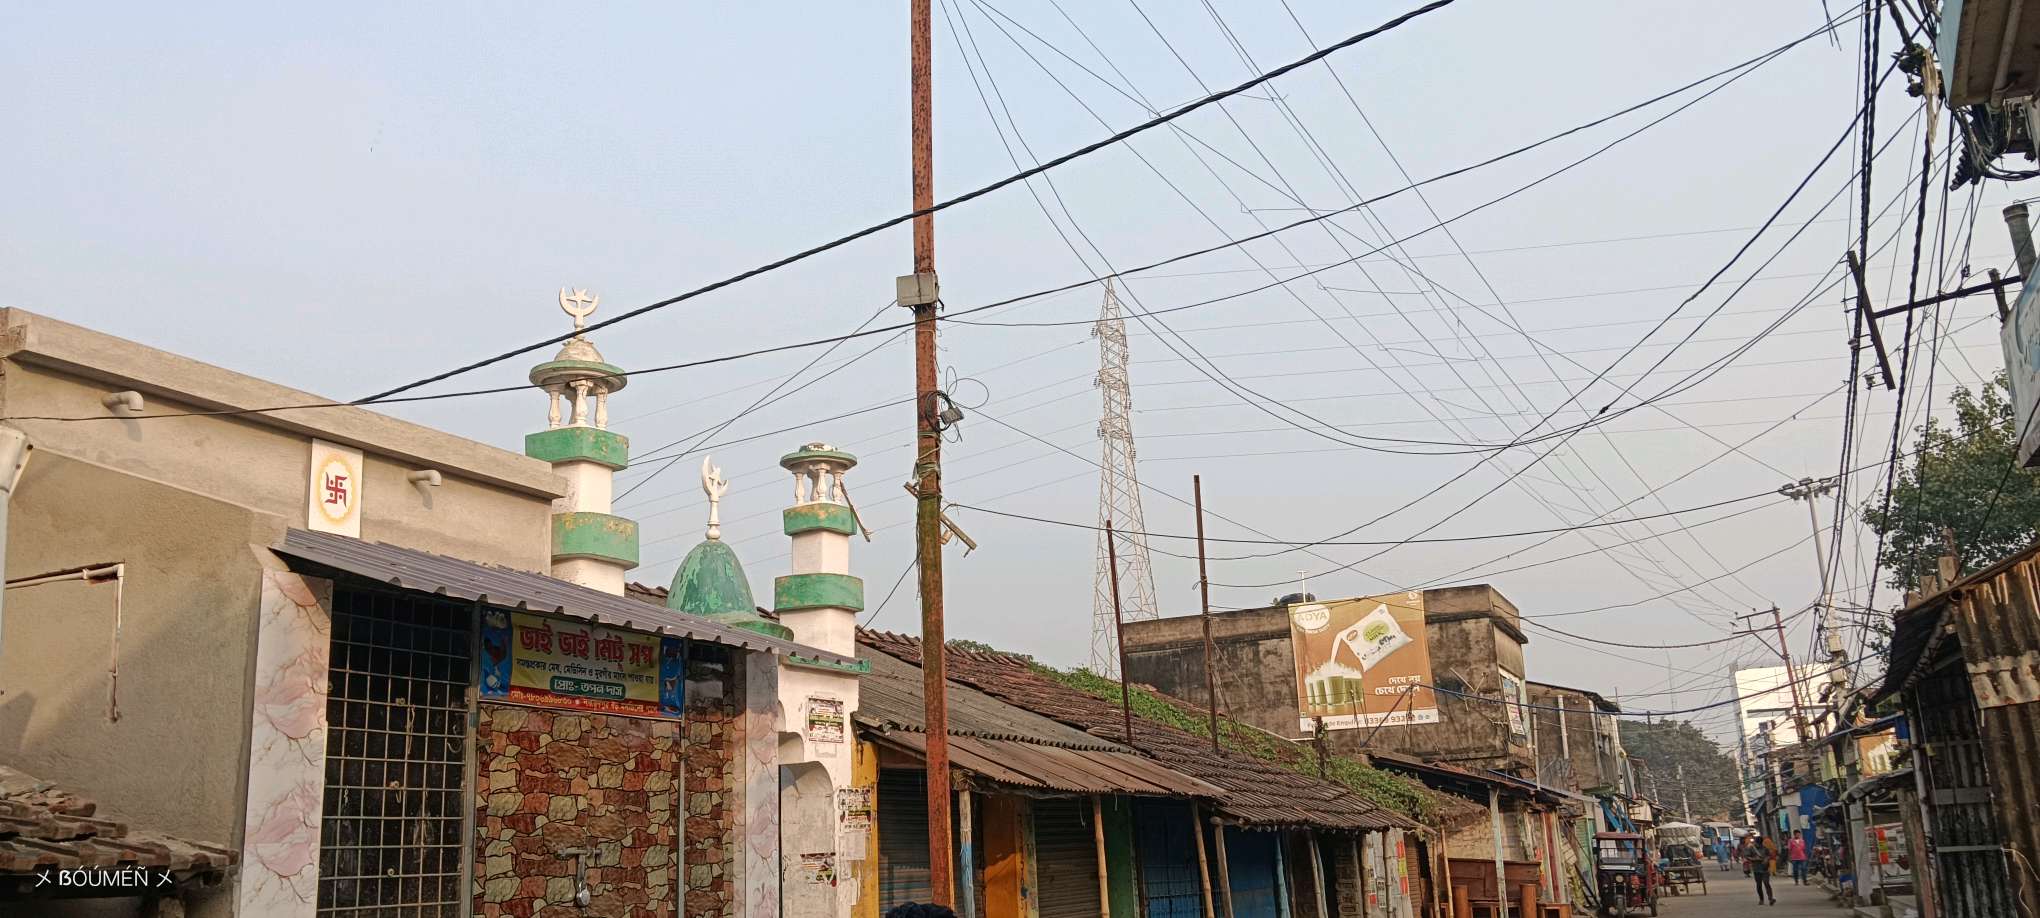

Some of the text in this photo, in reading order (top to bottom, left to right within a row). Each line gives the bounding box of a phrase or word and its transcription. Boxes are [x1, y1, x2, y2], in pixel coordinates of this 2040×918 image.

[518, 622, 553, 655] ভাই
[558, 628, 590, 660] ভাই
[580, 682, 605, 694] তপন
[606, 685, 623, 697] দাস
